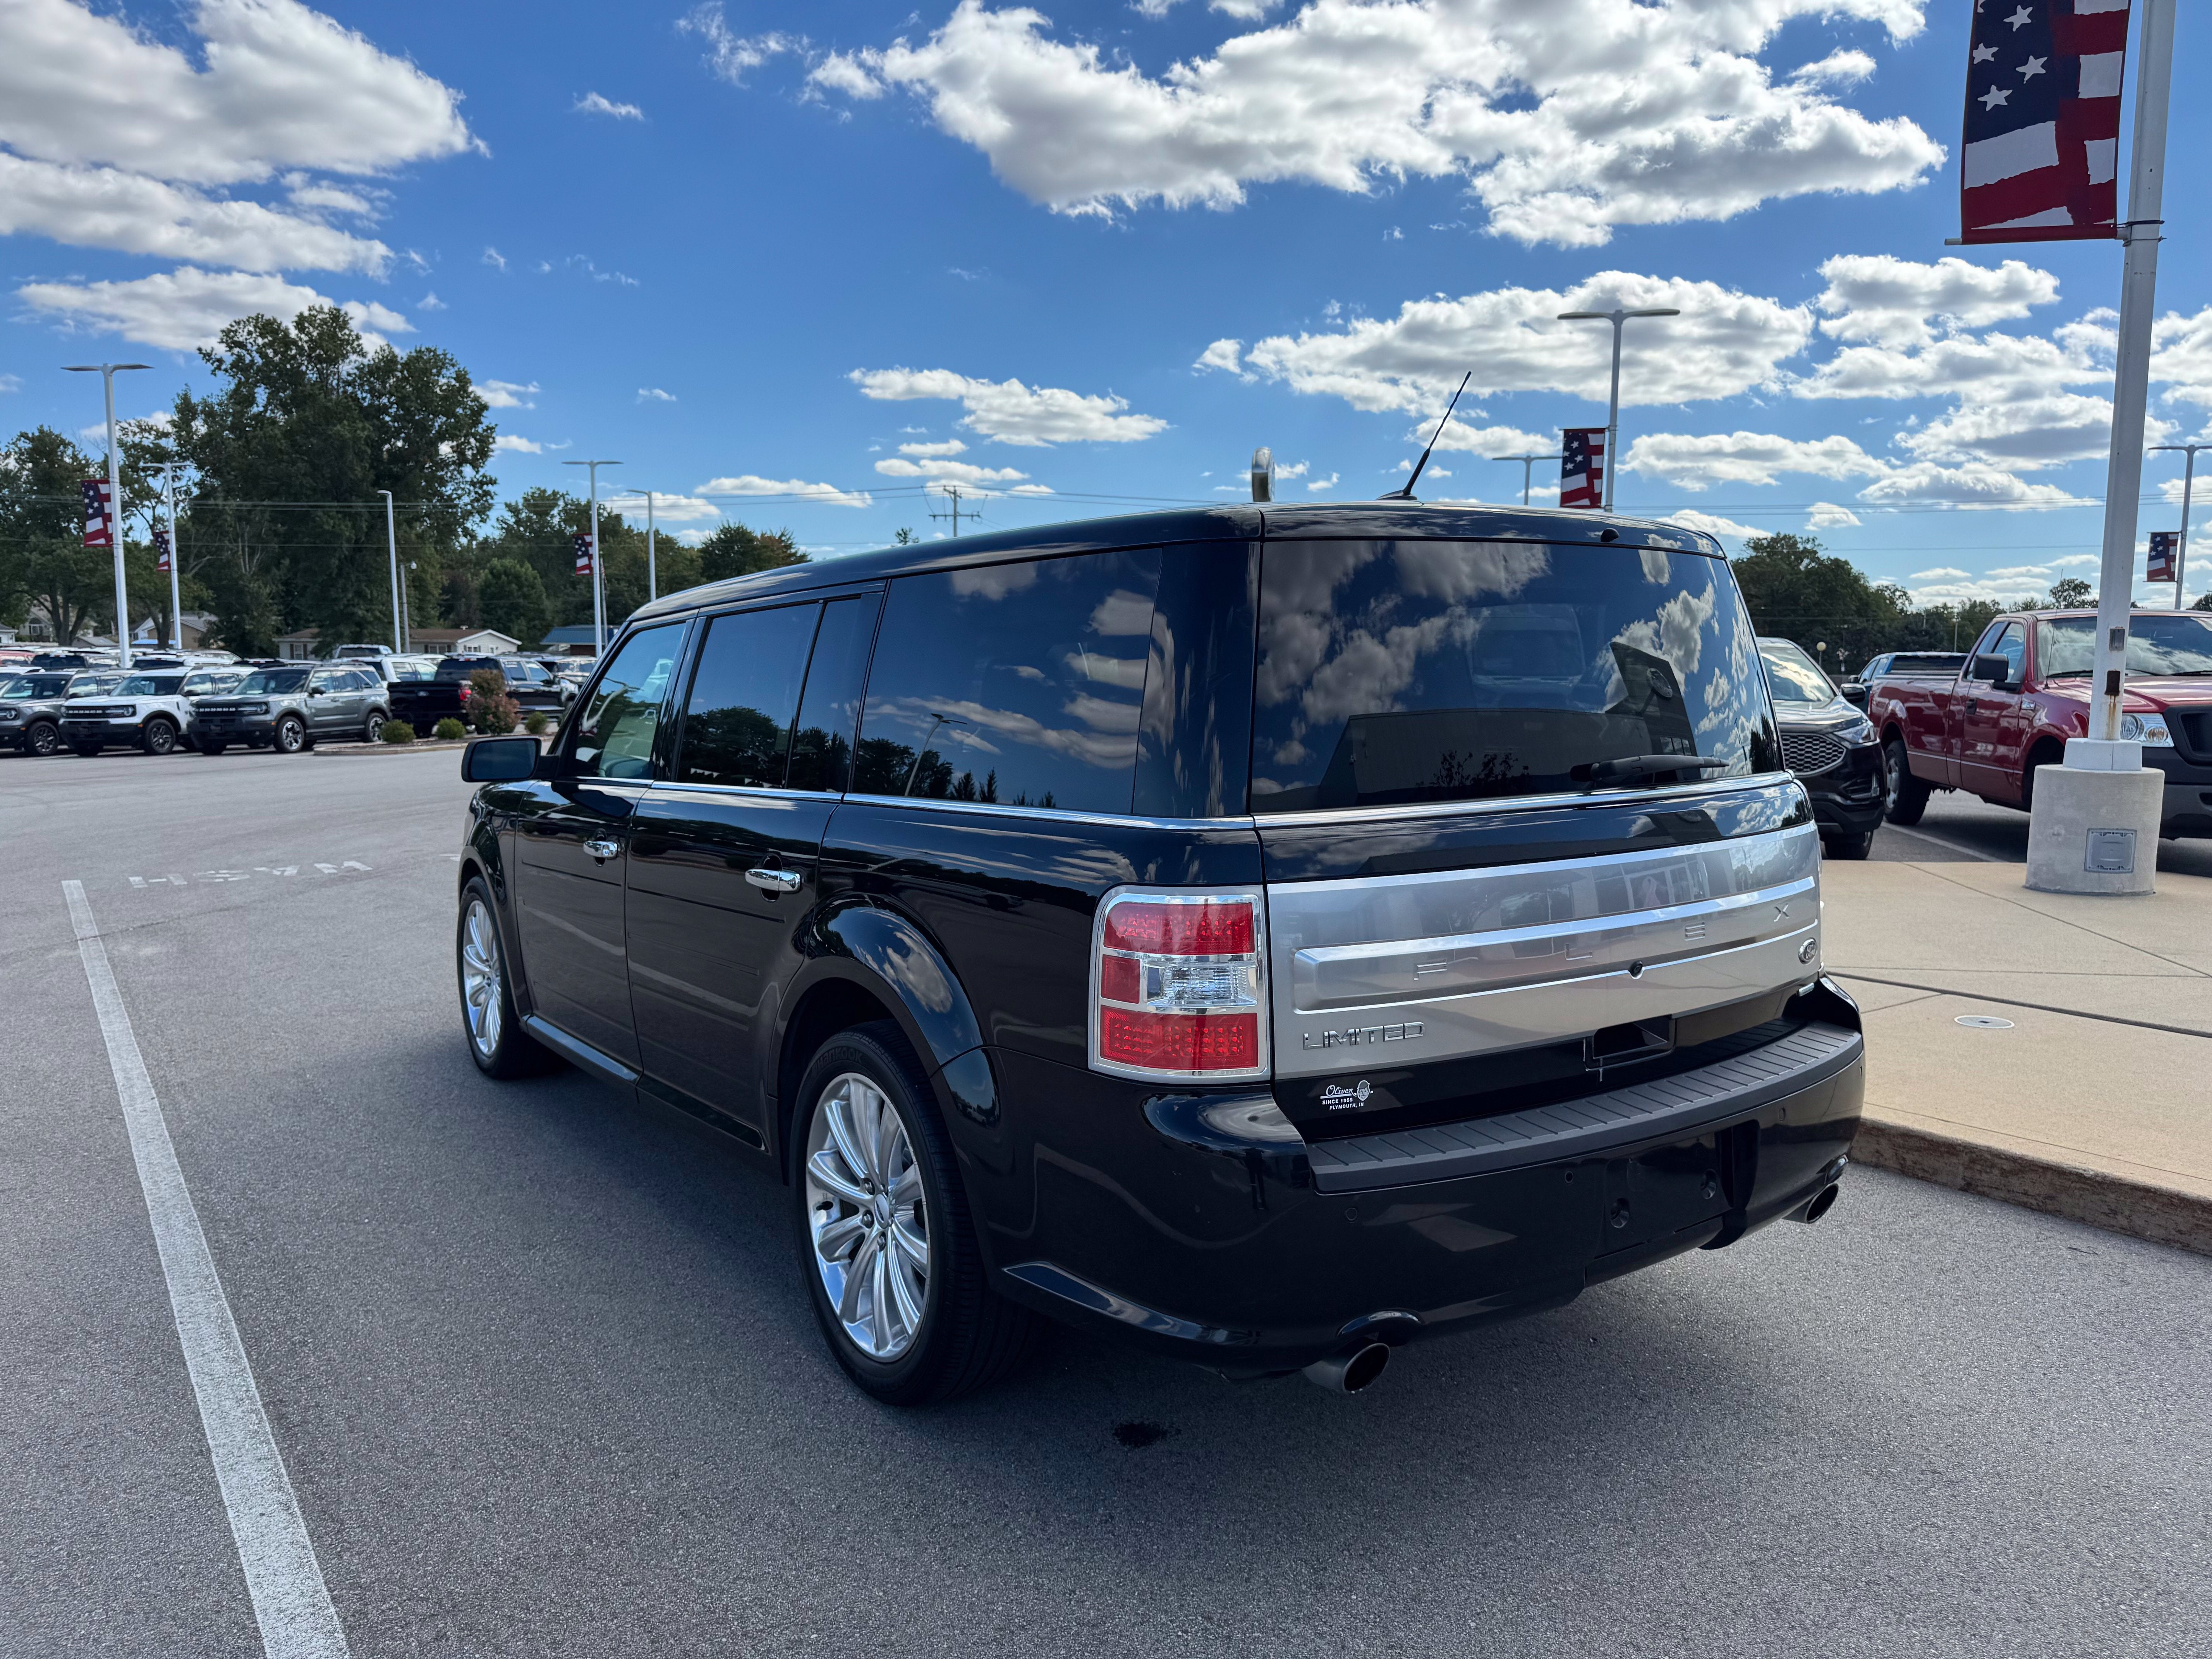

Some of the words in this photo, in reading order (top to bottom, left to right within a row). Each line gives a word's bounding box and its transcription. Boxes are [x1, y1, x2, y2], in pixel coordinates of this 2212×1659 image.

[1413, 903, 1790, 981] FLEX
[1303, 1021, 1425, 1050] LIMITED
[1326, 1085, 1357, 1097] Oliver
